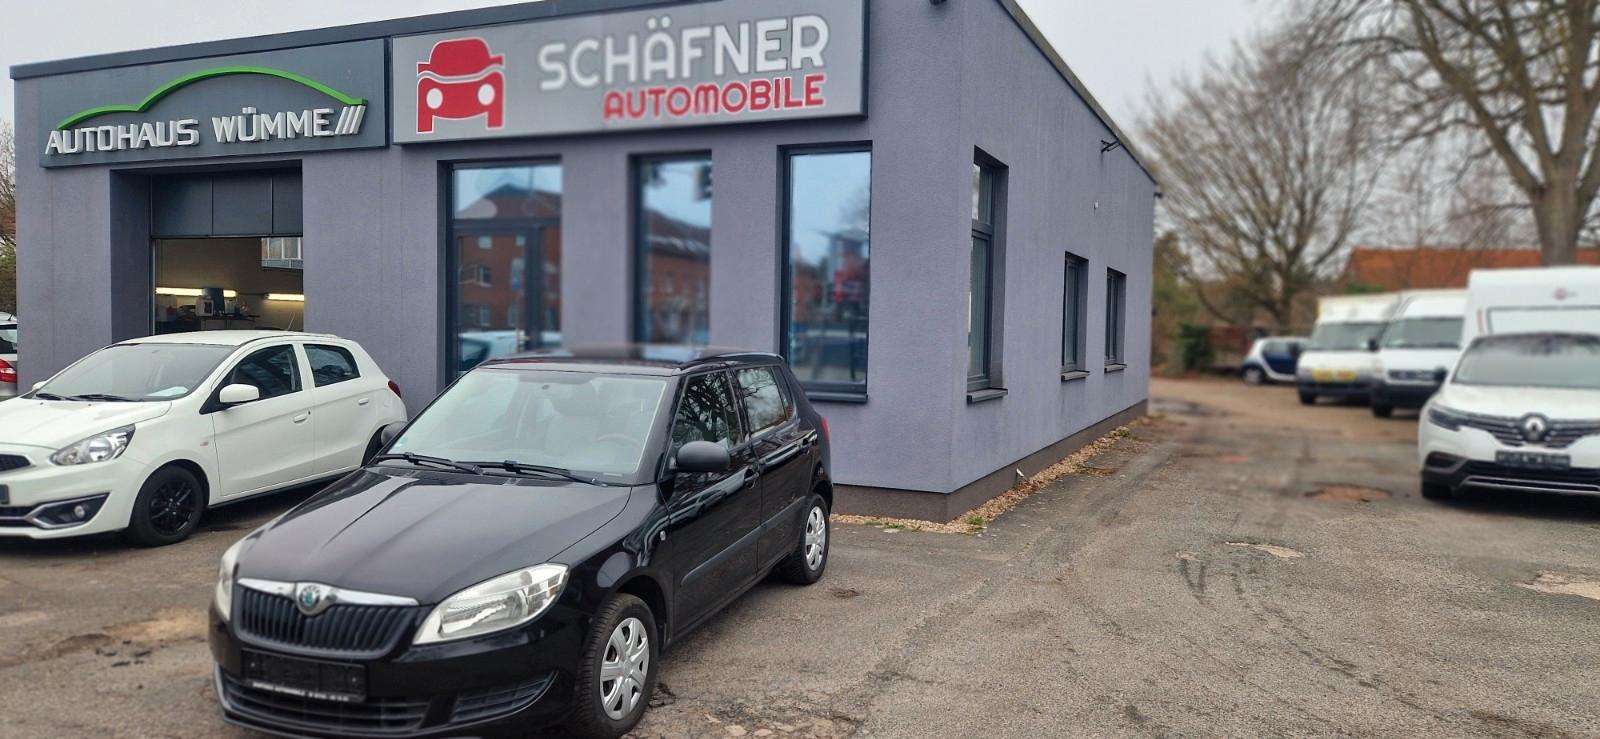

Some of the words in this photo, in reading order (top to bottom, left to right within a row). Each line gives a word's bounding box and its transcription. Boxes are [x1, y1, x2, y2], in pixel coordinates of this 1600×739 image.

[538, 15, 829, 91] SCHÄFNER
[604, 74, 825, 120] AUTOMOBILE
[45, 119, 199, 154] AUTOHAUS
